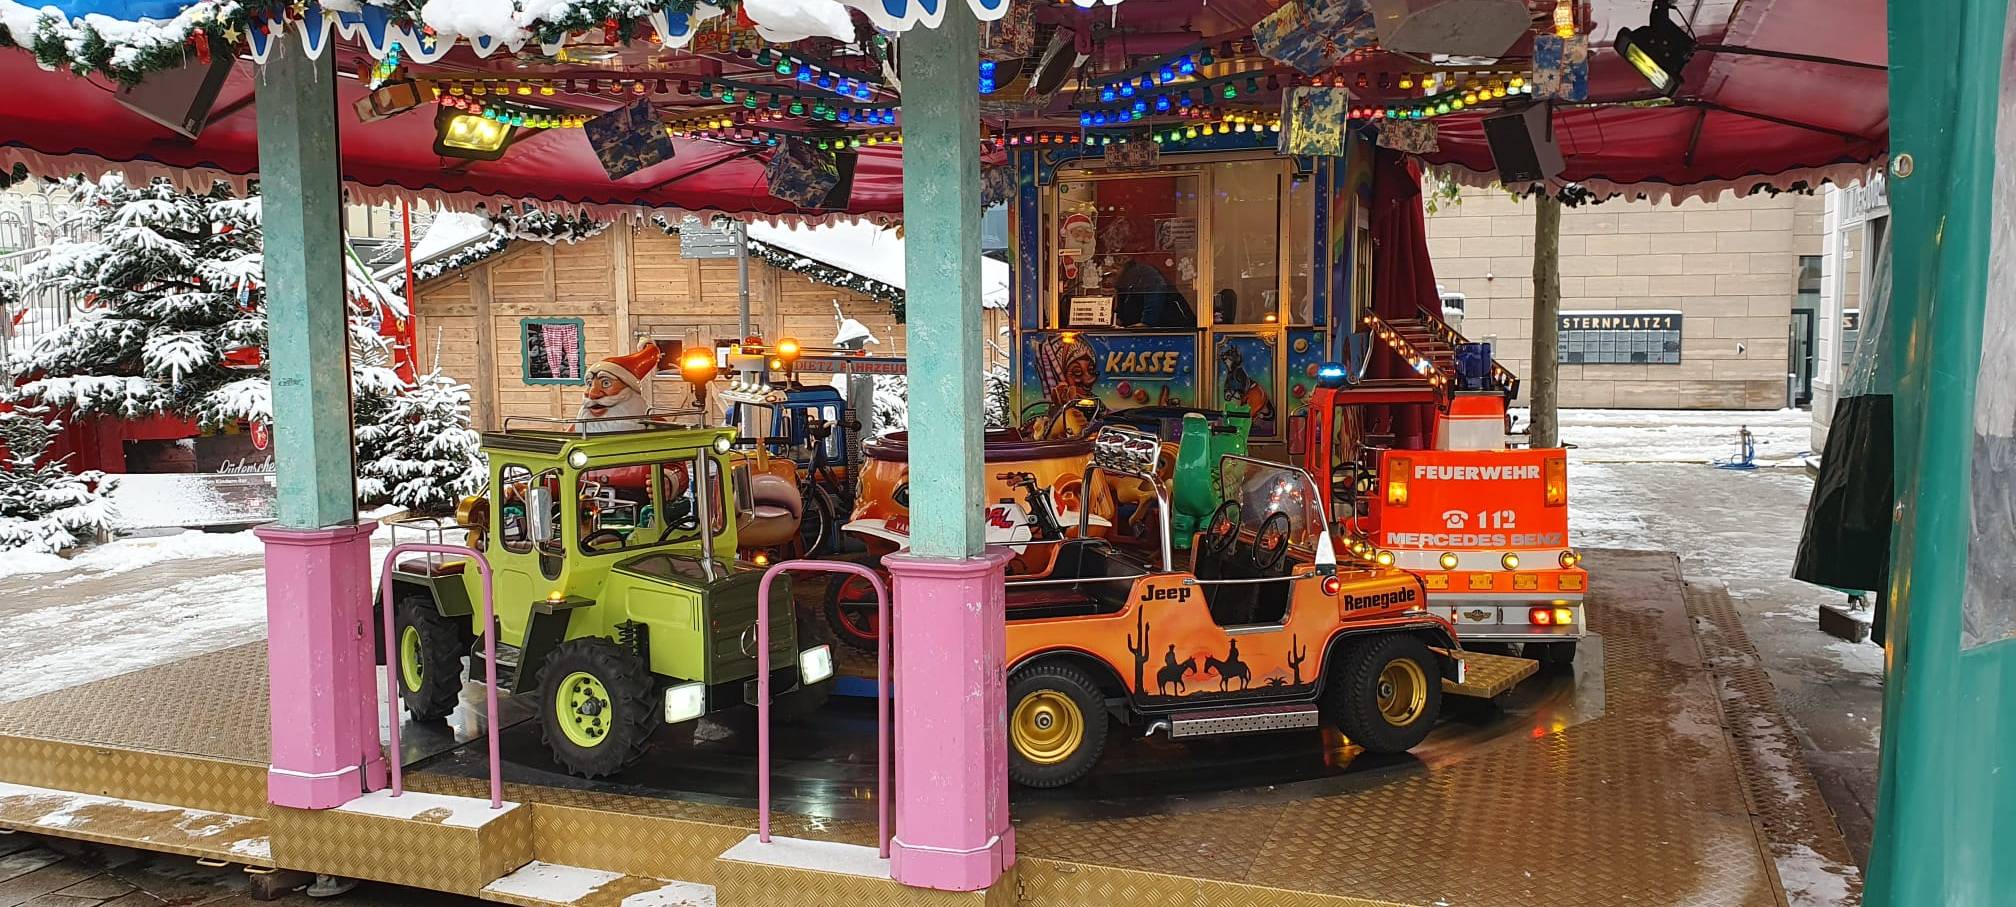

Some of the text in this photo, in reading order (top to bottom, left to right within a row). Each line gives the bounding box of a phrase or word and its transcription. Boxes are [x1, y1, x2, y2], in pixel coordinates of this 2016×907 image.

[1563, 317, 1672, 329] STERNPLATZ 1
[795, 359, 833, 372] DIETZ
[1105, 351, 1180, 373] KASSE
[216, 454, 277, 473] Lüdensche
[1414, 465, 1540, 481] FEUERWEHR
[1477, 508, 1516, 529] 112
[1387, 532, 1563, 547] MERCEDES BENZ
[1141, 584, 1191, 602] Jeep
[1344, 586, 1416, 612] Renegade
